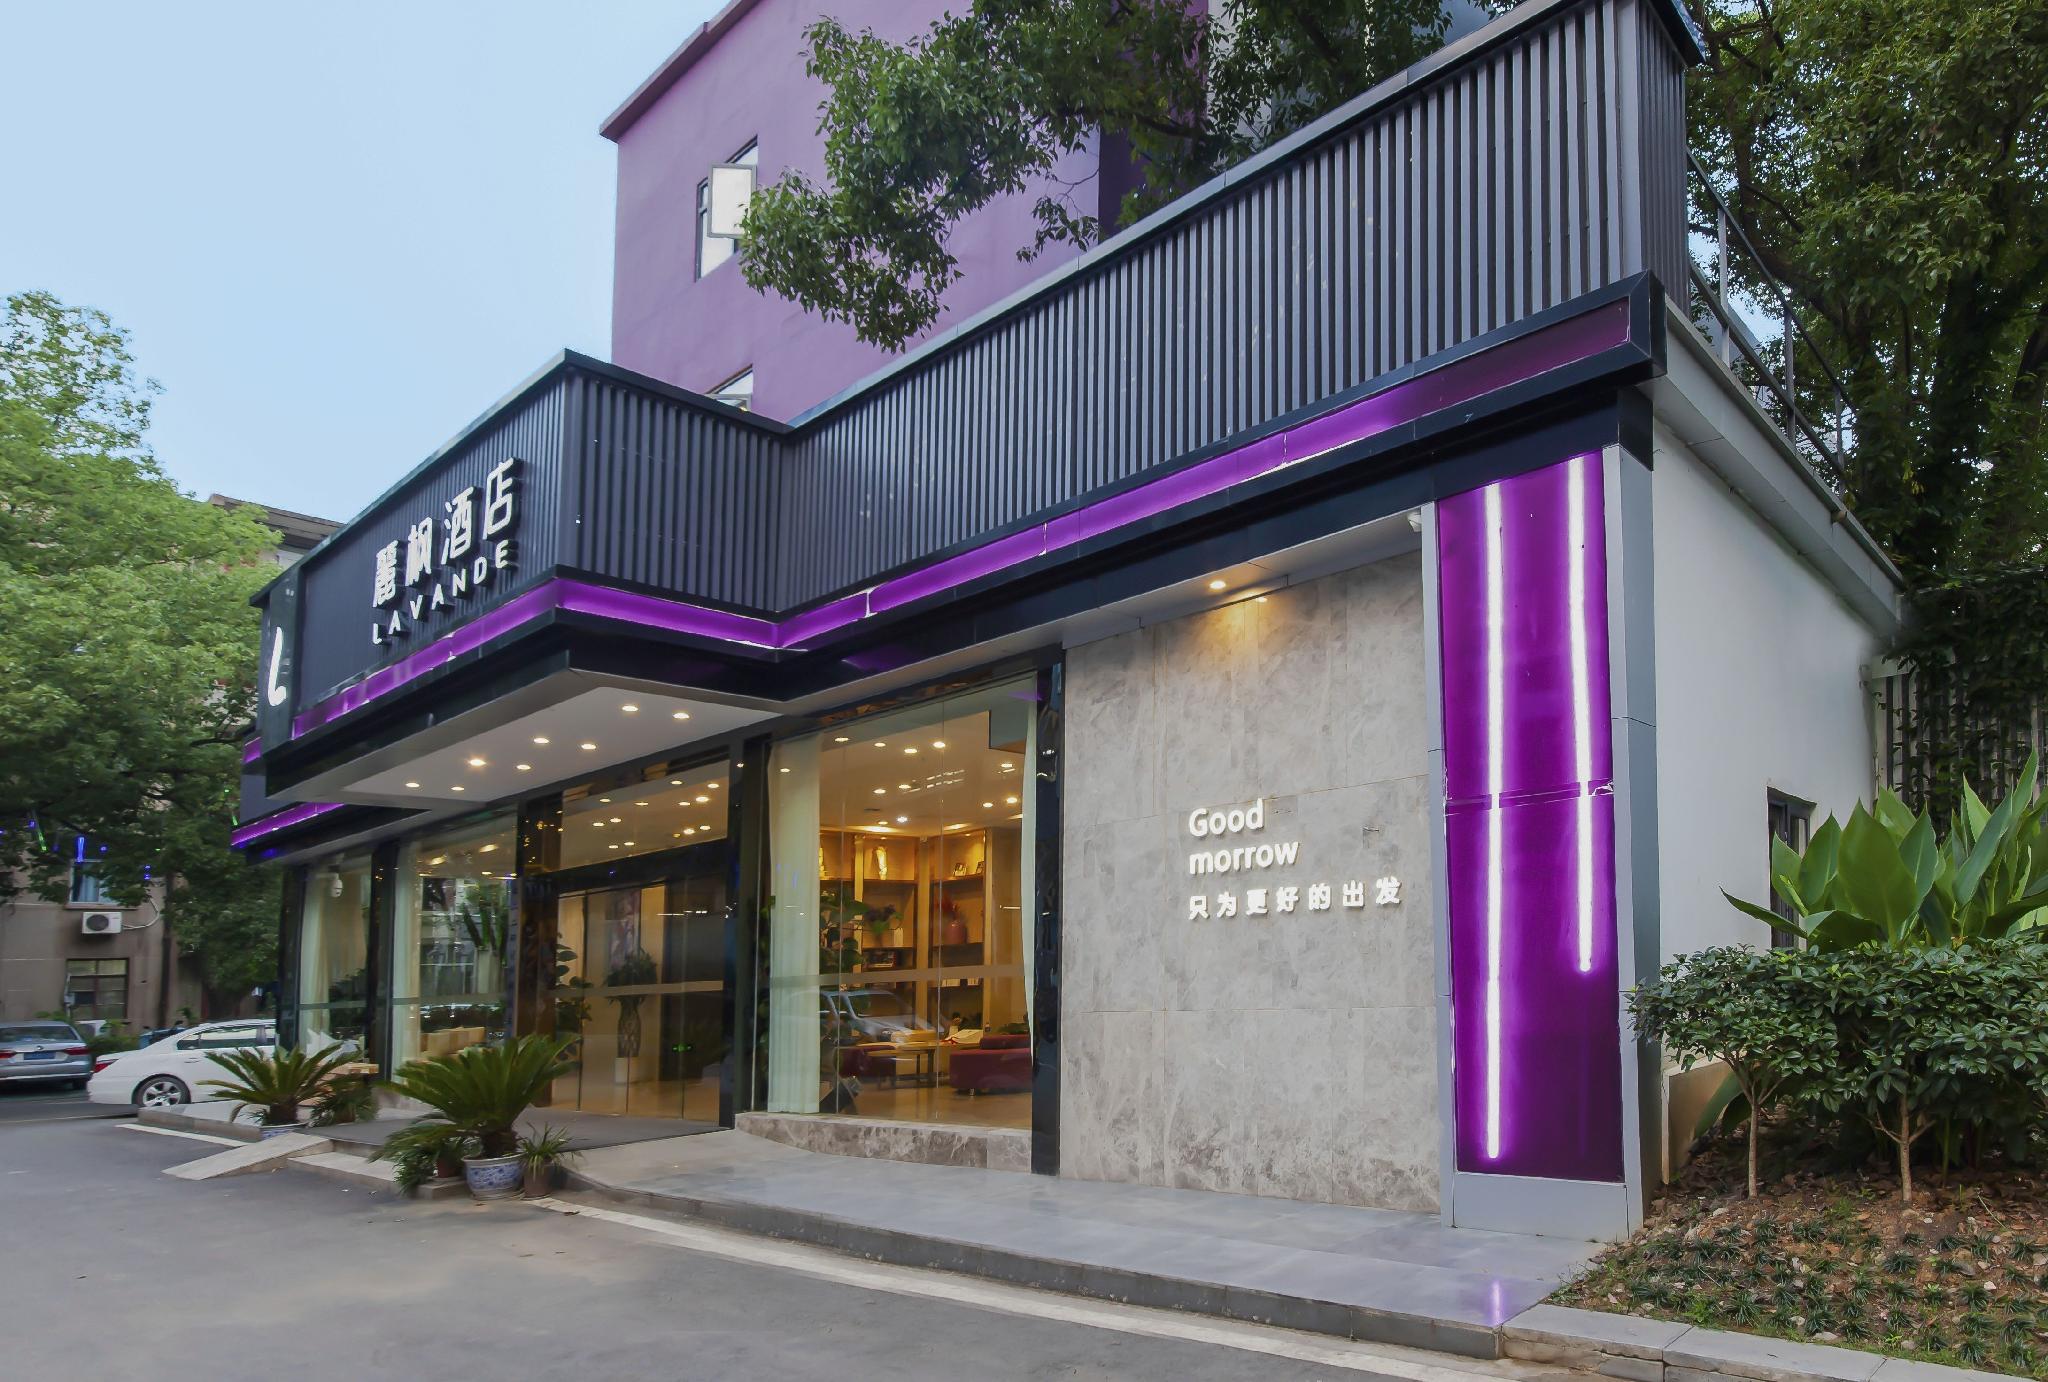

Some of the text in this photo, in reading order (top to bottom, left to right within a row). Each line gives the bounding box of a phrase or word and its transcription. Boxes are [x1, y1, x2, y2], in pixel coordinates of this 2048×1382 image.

[373, 540, 509, 645] LAVANDE
[1189, 798, 1265, 837] Good
[1189, 841, 1299, 875] morrow
[1188, 876, 1401, 920] 只为更好的出发
